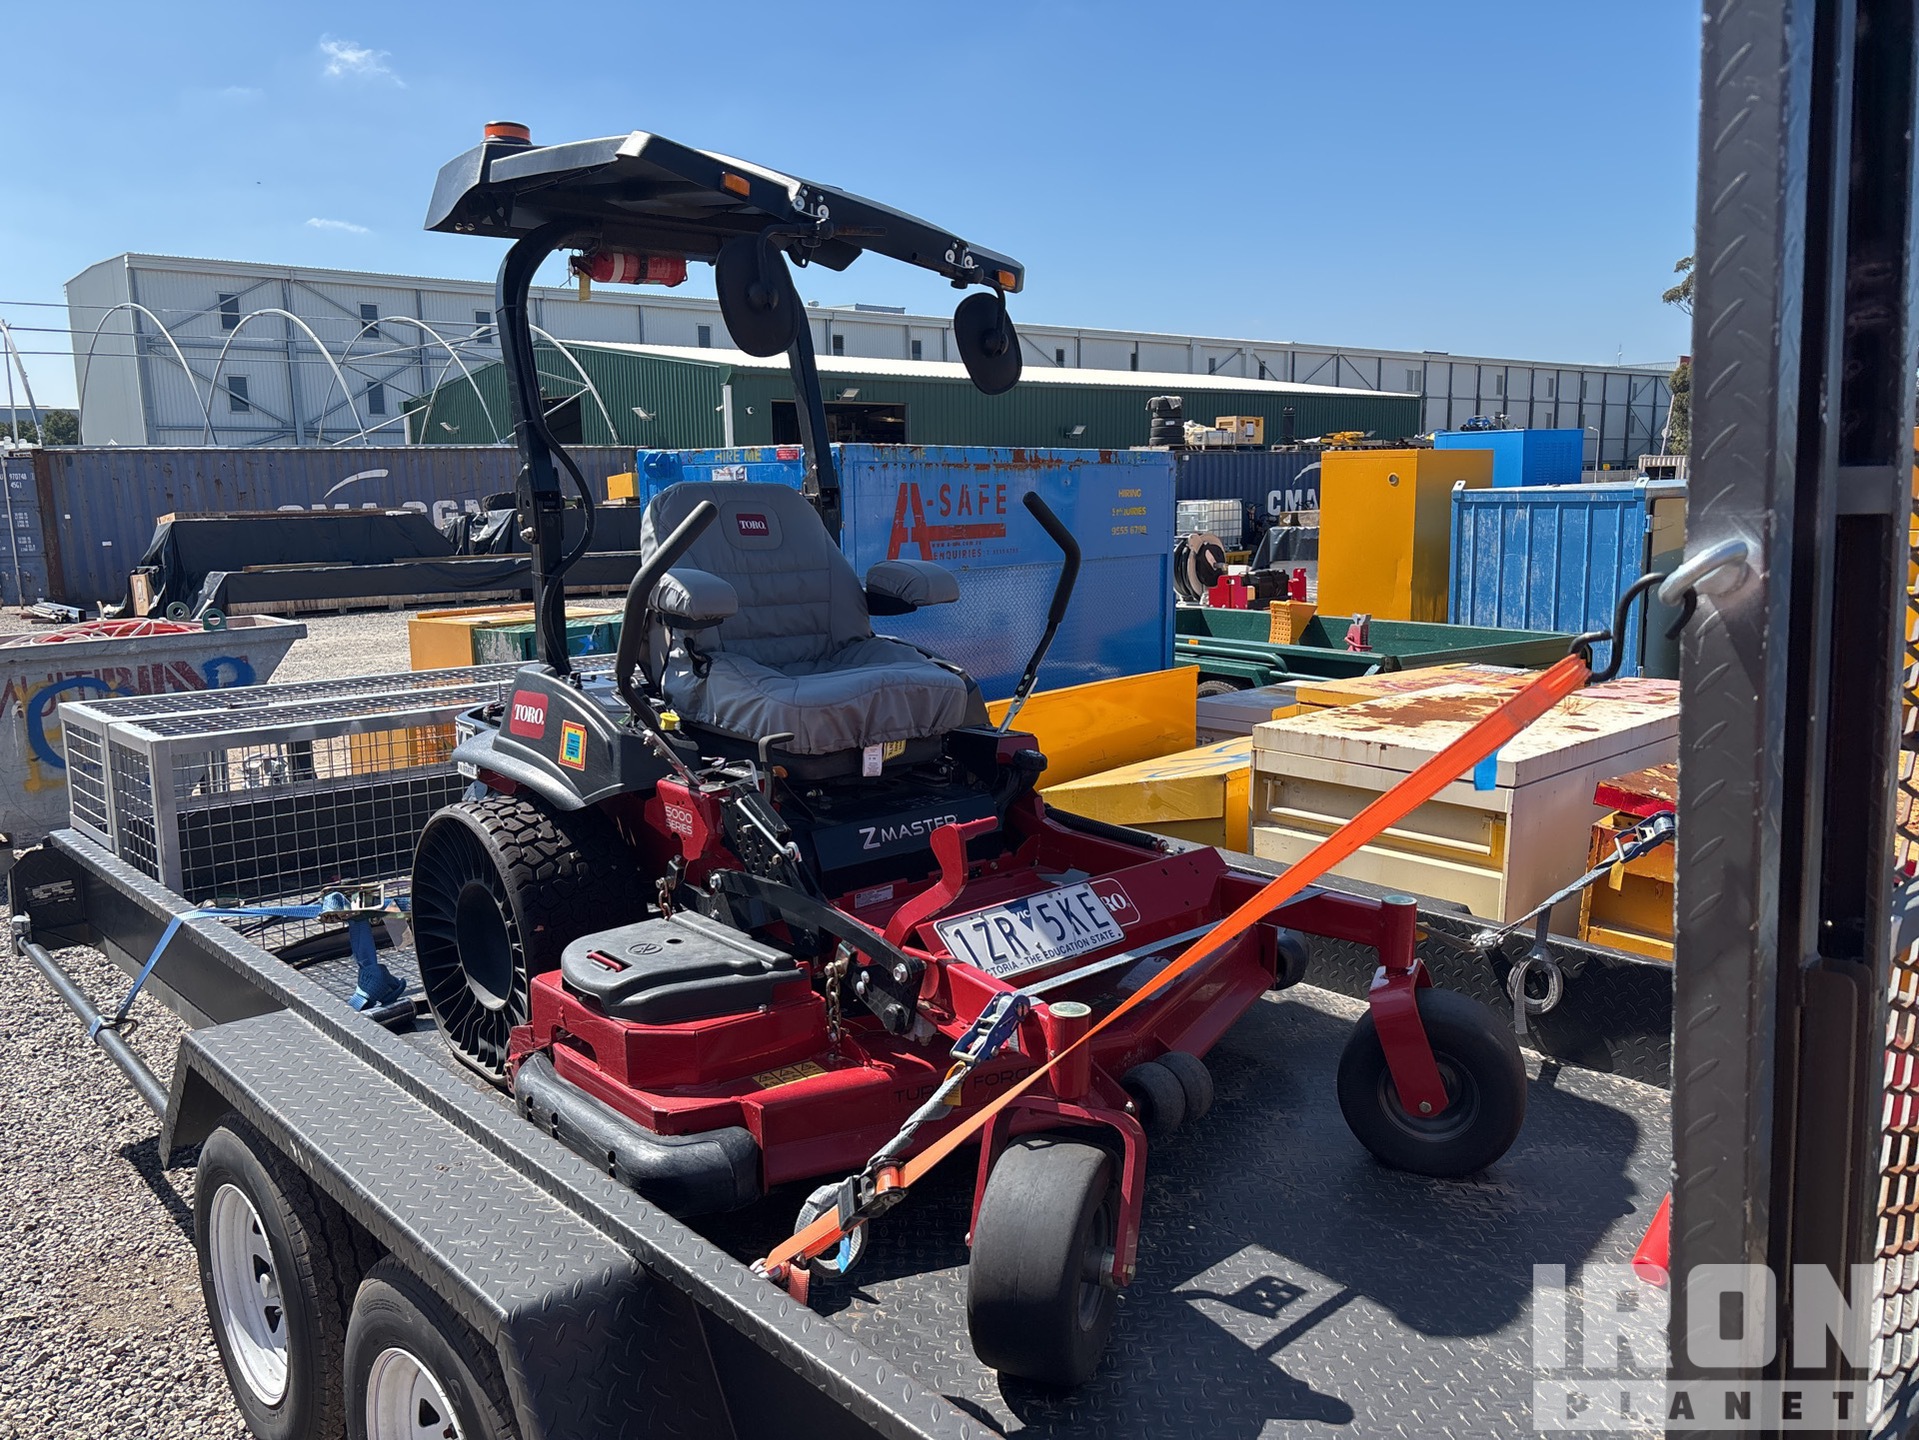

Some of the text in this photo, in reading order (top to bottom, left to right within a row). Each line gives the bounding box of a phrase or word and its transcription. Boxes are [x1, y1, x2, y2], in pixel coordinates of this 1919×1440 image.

[714, 449, 740, 462] HIRE
[744, 449, 762, 462] ME
[1118, 488, 1142, 498] HIRING
[1267, 488, 1319, 516] CMA
[738, 519, 767, 530] TORO
[886, 482, 1007, 561] A-SAFE
[932, 548, 982, 560] ENQUIRIES
[513, 703, 545, 726] TORO
[665, 805, 693, 824] 5000
[666, 818, 693, 836] SERIES
[859, 826, 881, 850] Z
[1100, 892, 1128, 913] RO
[1016, 908, 1031, 920] VIC
[953, 891, 1111, 970] 1ZR 5KE
[985, 960, 1020, 977] CTORIA
[1024, 954, 1044, 969] THE
[1044, 938, 1091, 961] EDUCATION
[1090, 929, 1116, 945] STATE
[894, 1083, 941, 1104] TUR
